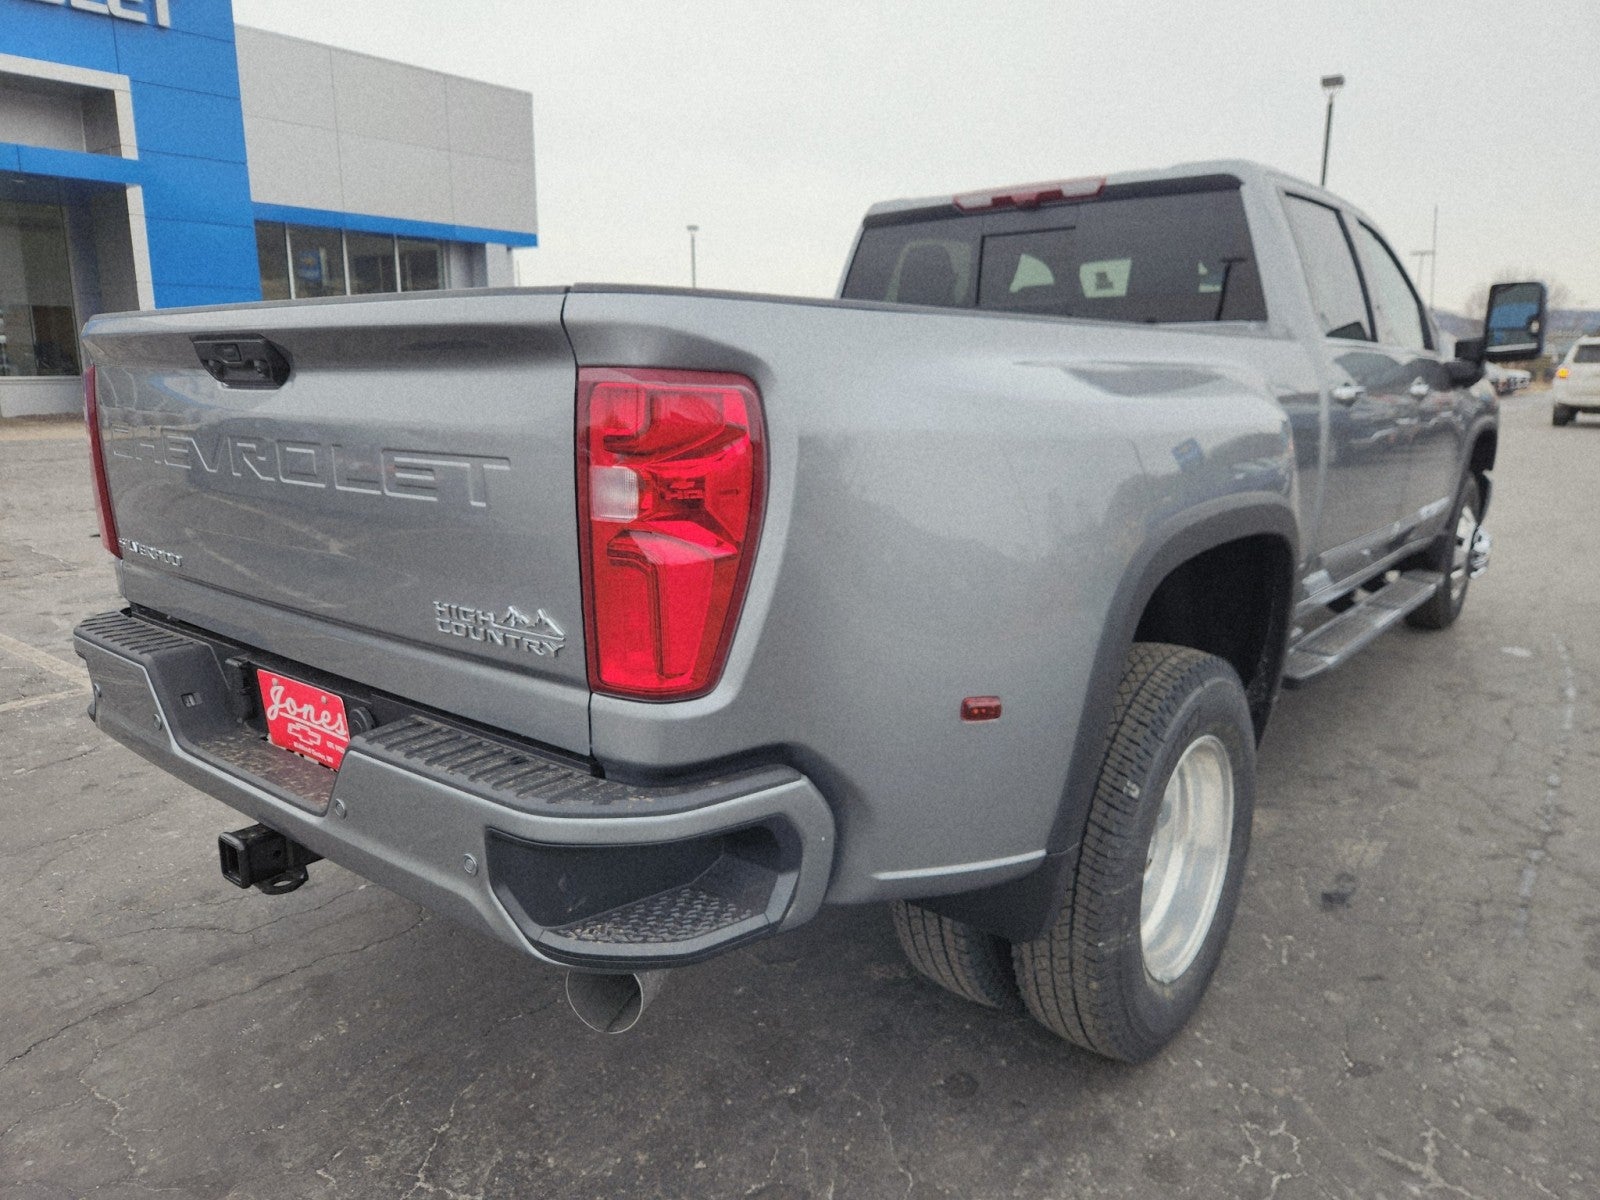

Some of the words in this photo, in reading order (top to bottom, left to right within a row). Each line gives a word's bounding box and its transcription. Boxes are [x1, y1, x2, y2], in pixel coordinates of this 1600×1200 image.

[110, 422, 511, 508] CHEVROLET
[433, 601, 495, 626] HIGH
[435, 617, 566, 658] COUNTRY
[266, 685, 347, 736] Jones
